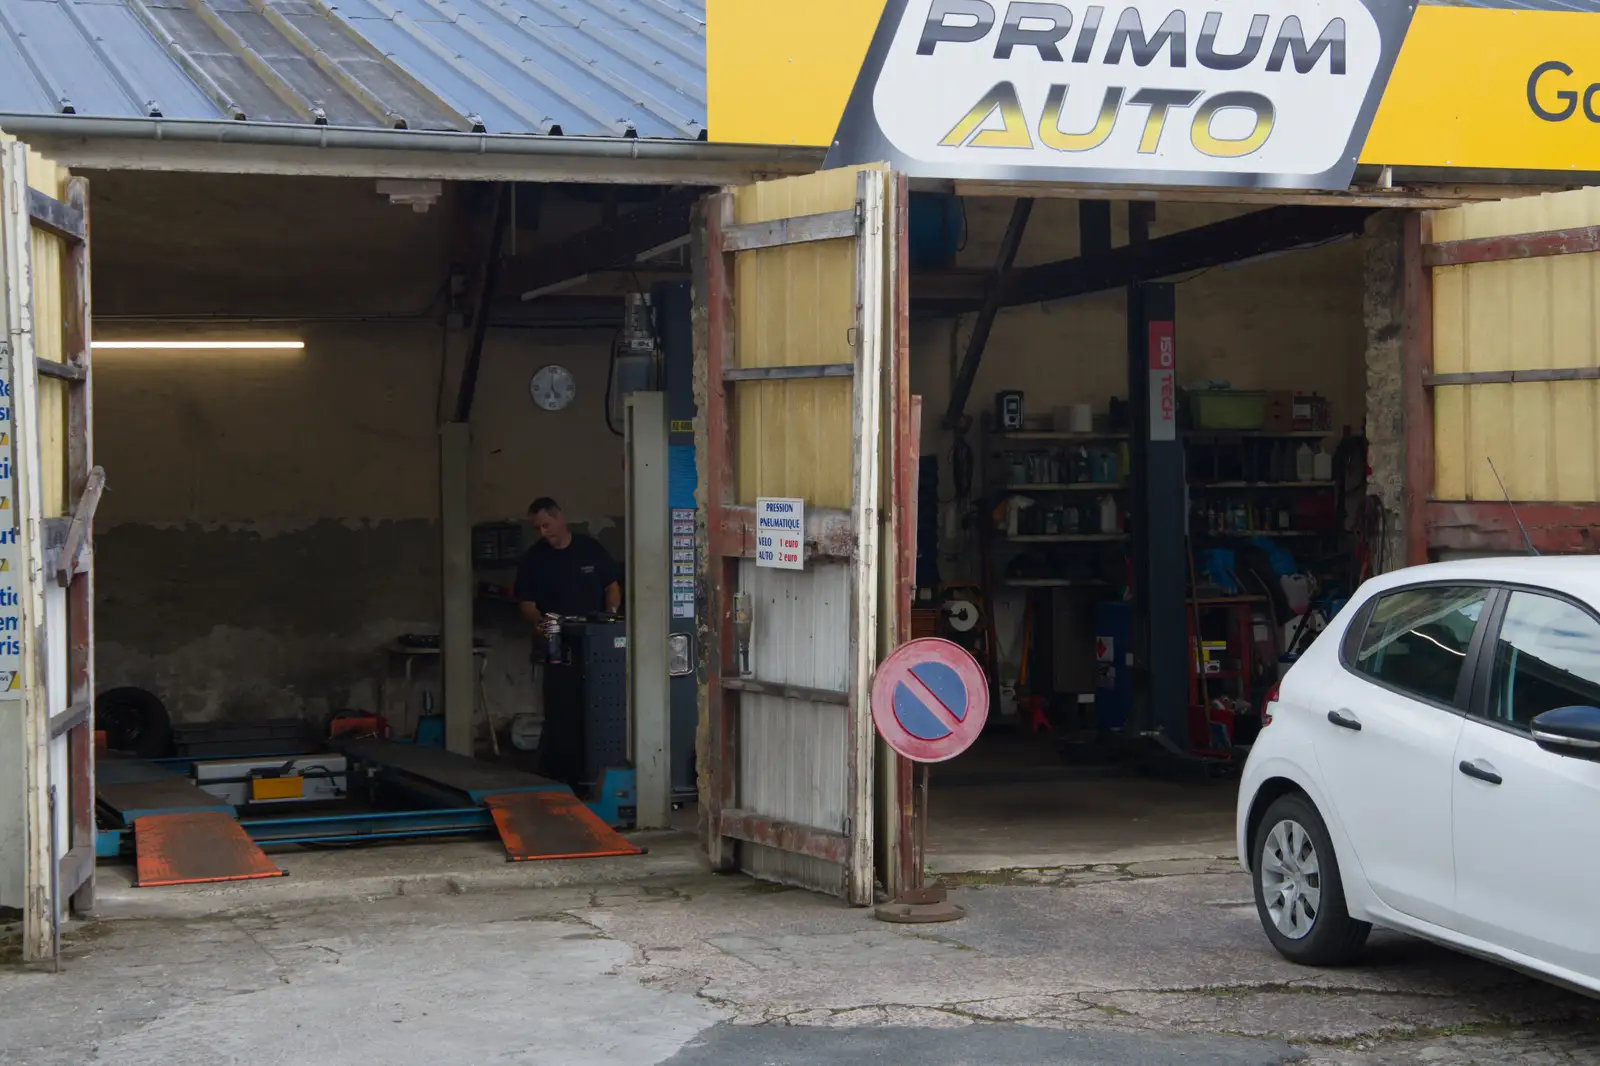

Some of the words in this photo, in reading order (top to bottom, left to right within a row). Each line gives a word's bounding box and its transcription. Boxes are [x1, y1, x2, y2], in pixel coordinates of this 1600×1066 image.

[915, 0, 1347, 75] PRIMUM
[937, 80, 1277, 158] AUTO
[1160, 336, 1172, 367] ISO
[1161, 373, 1172, 420] TECH
[766, 503, 793, 512] PRESSION
[760, 518, 799, 529] PNEUMATIQUE
[758, 537, 772, 546] VELO
[780, 539, 783, 547] 1
[785, 539, 798, 548] euro
[759, 551, 773, 560] AUTO
[778, 551, 783, 561] 2
[784, 553, 798, 562] euro
